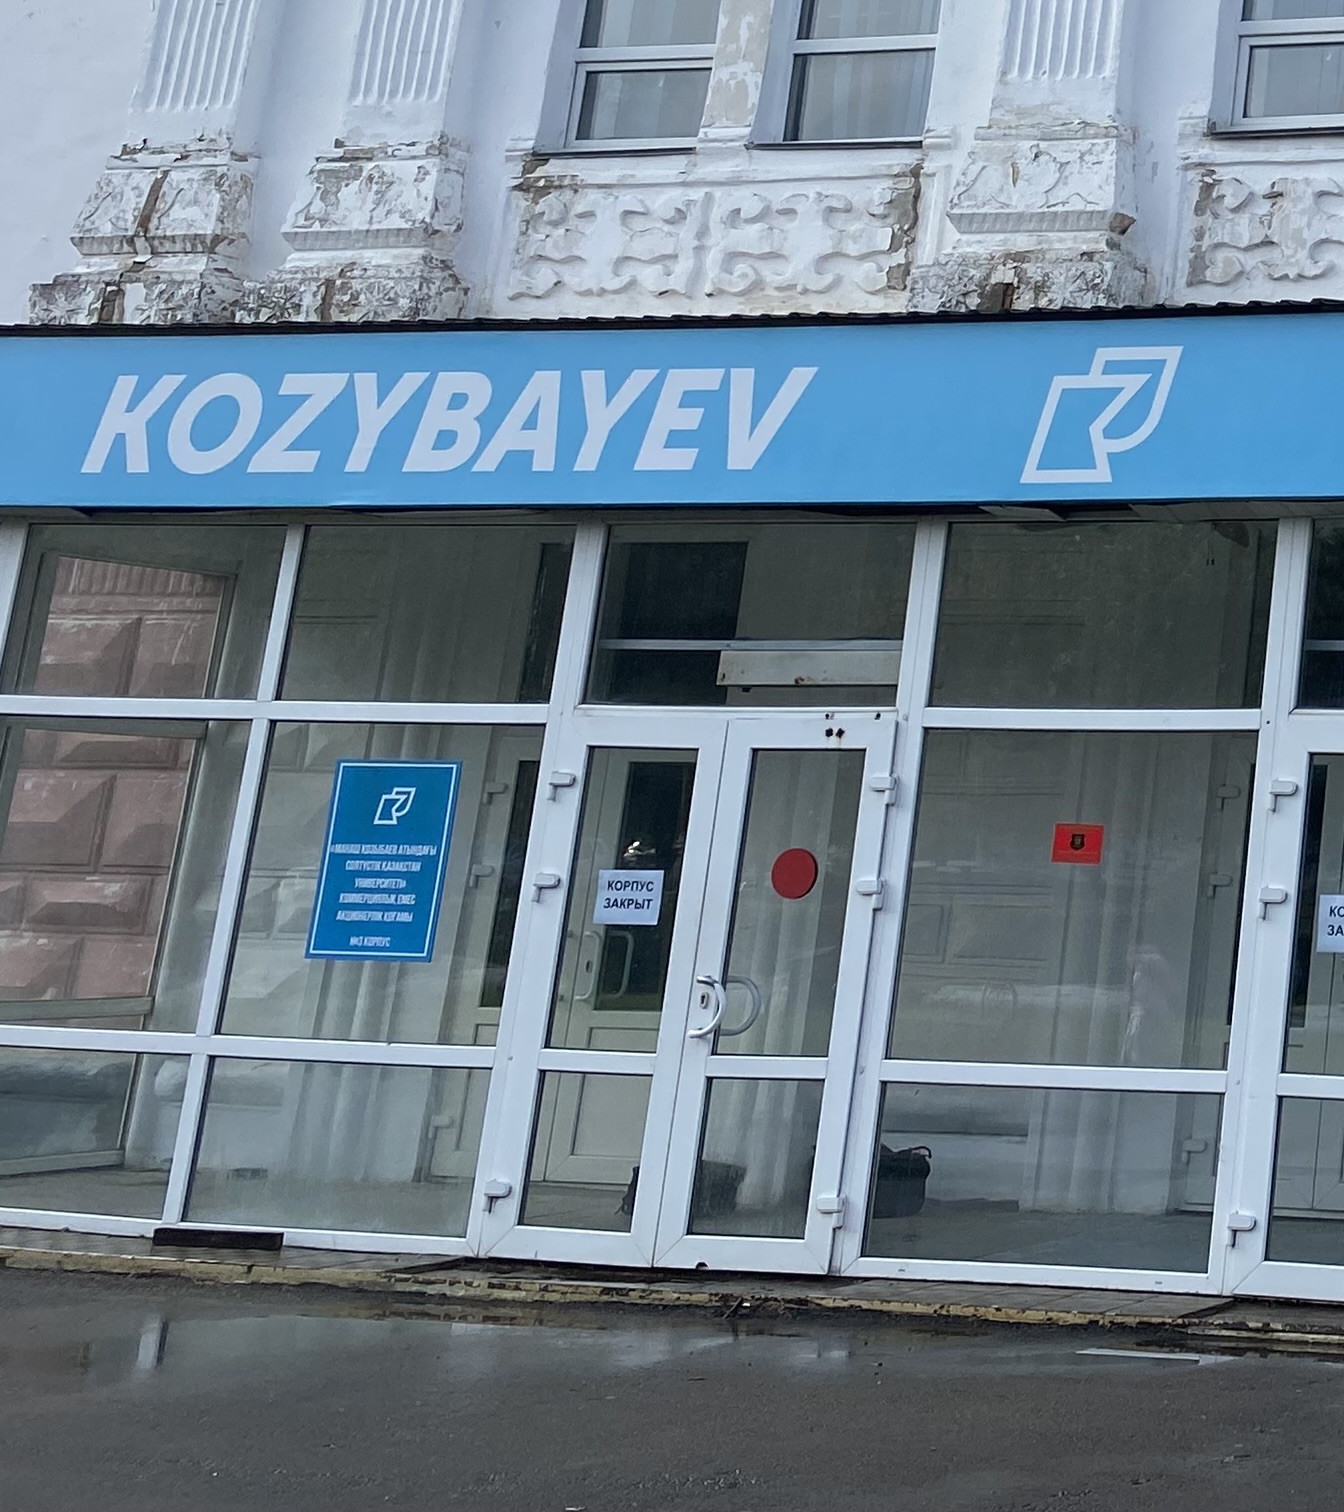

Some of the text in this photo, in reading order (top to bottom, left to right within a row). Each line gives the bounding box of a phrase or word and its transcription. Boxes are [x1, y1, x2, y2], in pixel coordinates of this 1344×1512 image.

[80, 365, 819, 476] KOZYBAYEV
[606, 880, 654, 892] КОРПУС
[603, 897, 653, 909] ЗАКРЫТ
